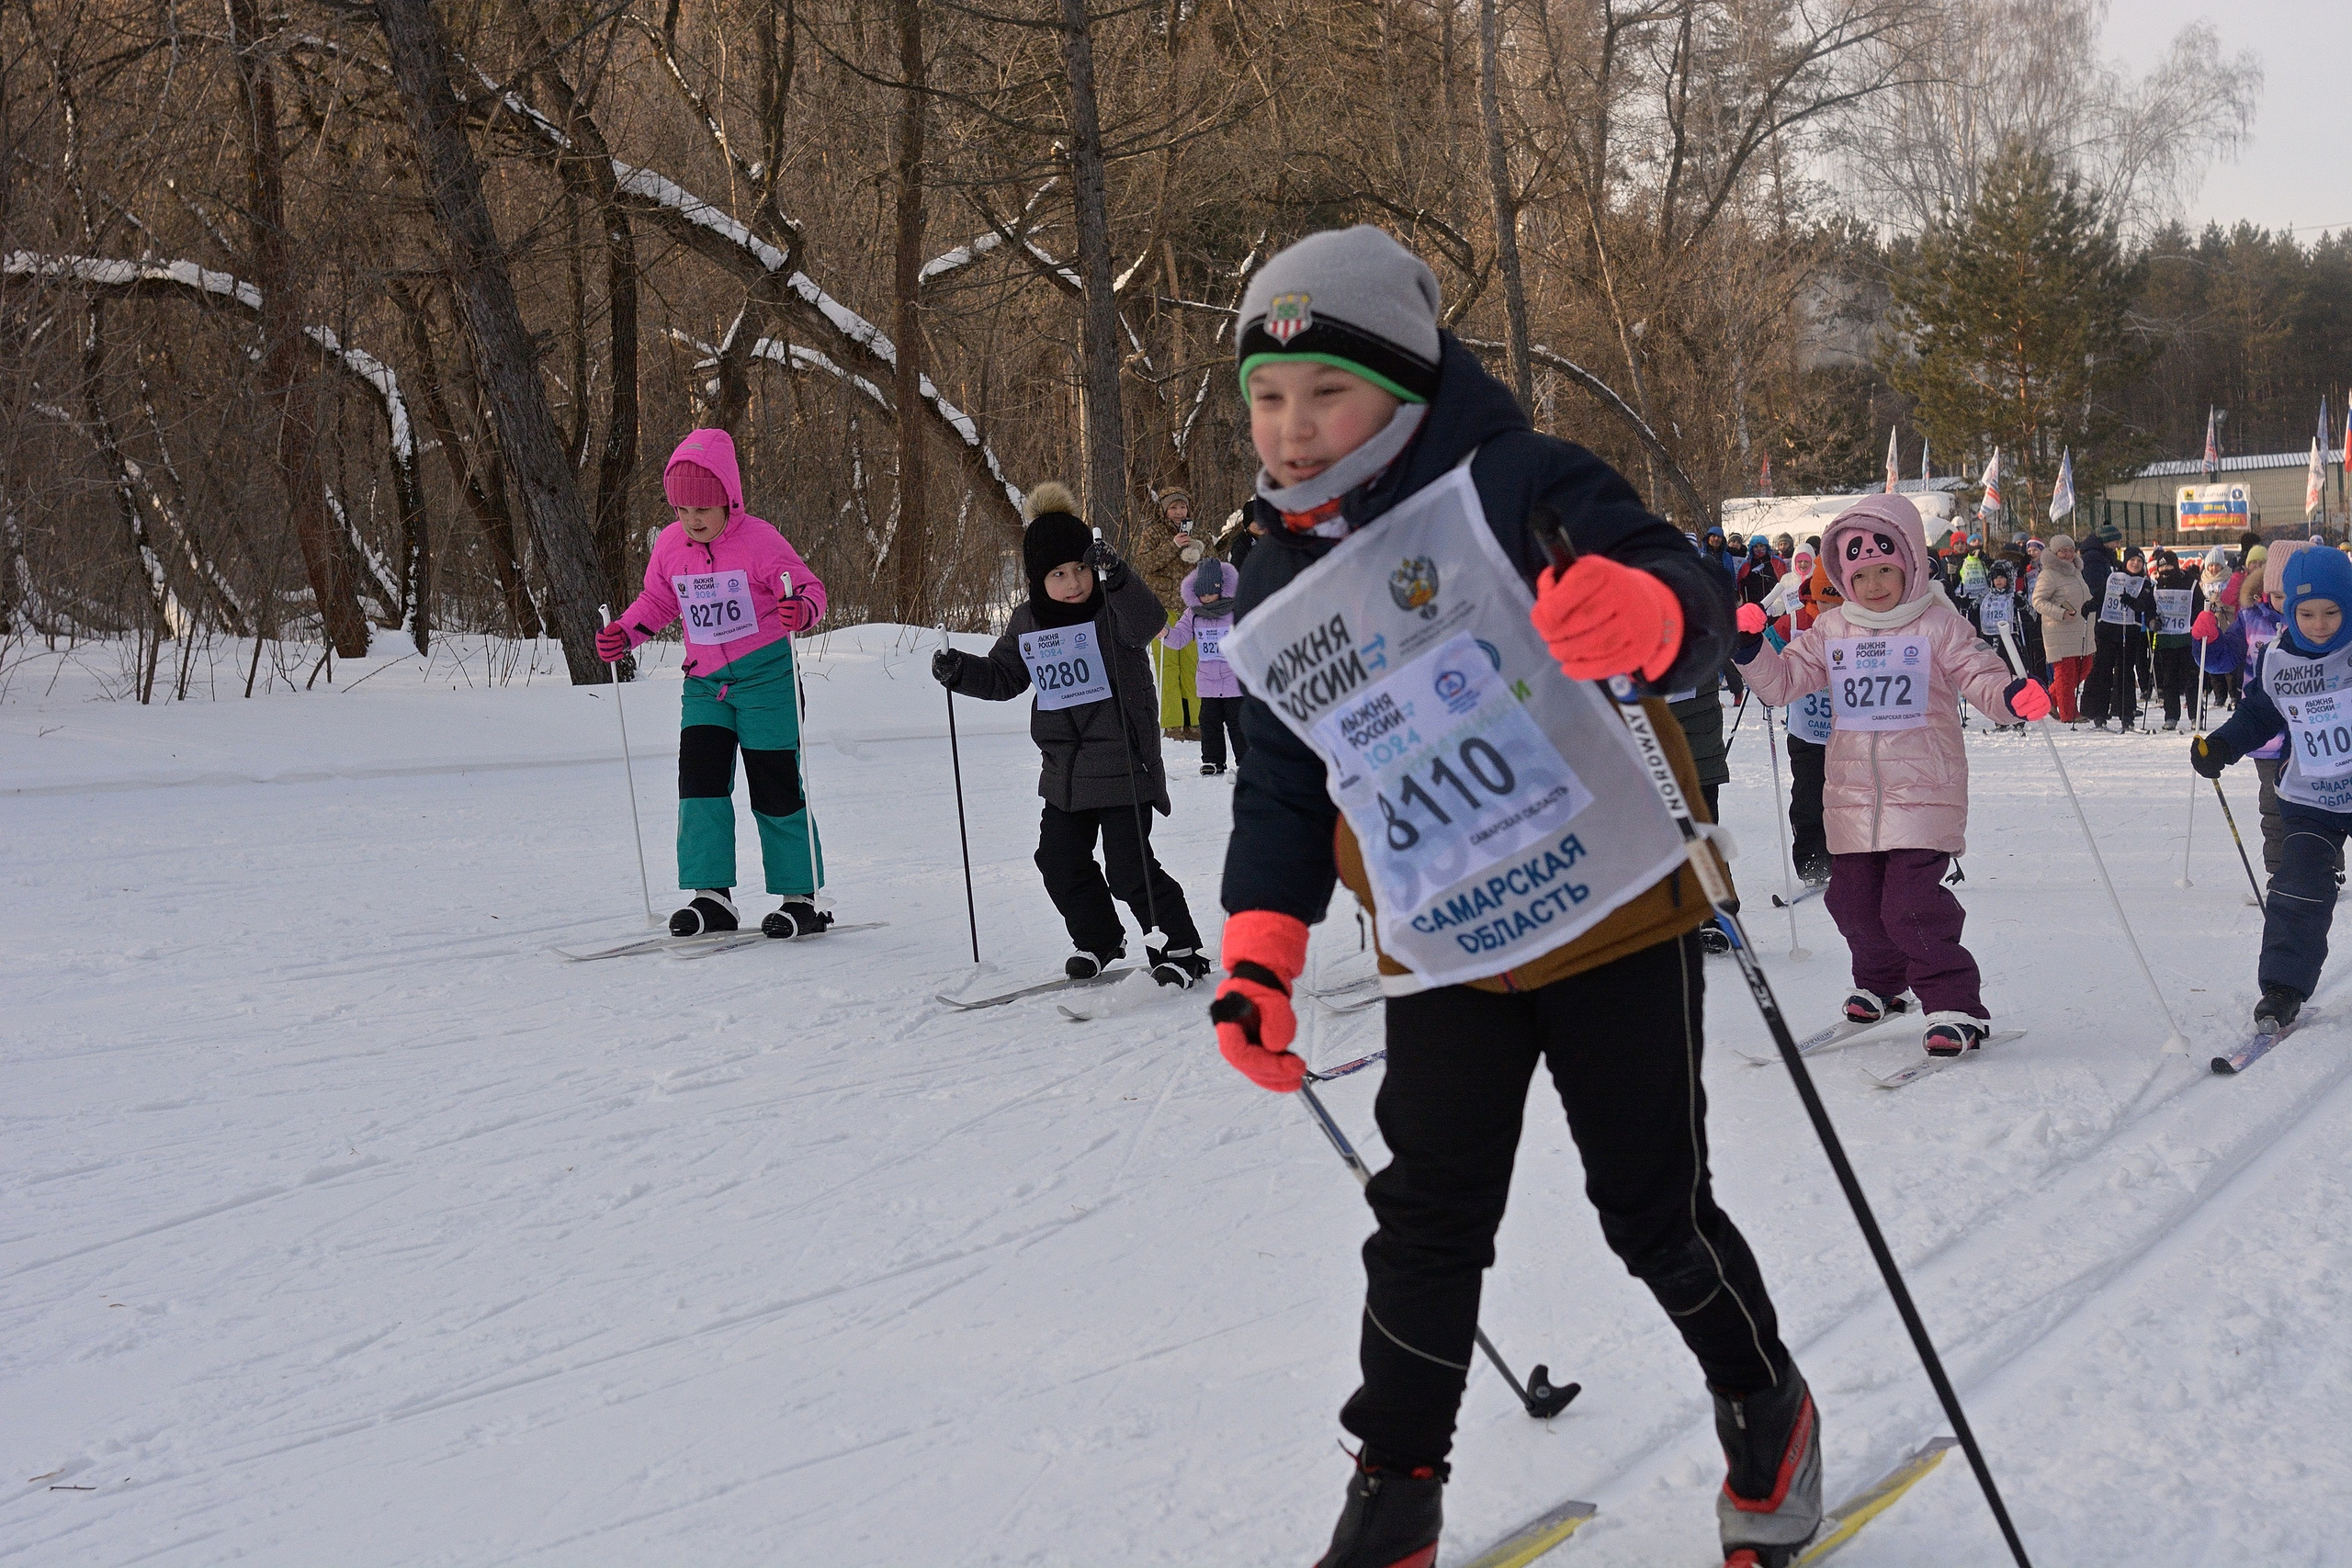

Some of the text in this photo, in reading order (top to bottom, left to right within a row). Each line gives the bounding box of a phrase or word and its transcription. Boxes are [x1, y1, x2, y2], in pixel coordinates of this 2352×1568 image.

[690, 600, 741, 626] 8276
[2163, 616, 2185, 629] 716
[1037, 633, 1058, 642] ЛЫЖНЯ
[1038, 640, 1060, 649] РОССИИ
[1856, 641, 1886, 650] ЛЫЖНЯ
[1039, 649, 1063, 658] 2024
[1266, 613, 1351, 694] ЛЫЖНЯ
[1856, 649, 1886, 658] РОССИИ
[1856, 659, 1886, 669] 2024
[2273, 664, 2324, 681] ЛЫЖНЯ
[1036, 658, 1090, 691] 8280
[1061, 691, 1085, 699] САМАРСКАЯ
[1844, 675, 1912, 707] 8272
[2275, 678, 2325, 695] РОССИИ
[2304, 697, 2334, 708] ЛЫЖНЯ
[2306, 705, 2335, 715] РОССИИ
[1340, 693, 1395, 738] ЛЫЖНЯ
[2309, 712, 2338, 724] 2024
[1348, 709, 1406, 750] РОССИИ
[2304, 726, 2352, 757] 810
[1627, 713, 1683, 811] NORDWAY
[1377, 738, 1516, 851] 8110
[1470, 785, 1568, 846] САМАРСКАЯ ОБЛАСТЬ
[1411, 832, 1588, 933] САМАРСКАЯ
[1456, 882, 1589, 954] ОБЛАСТЬ
